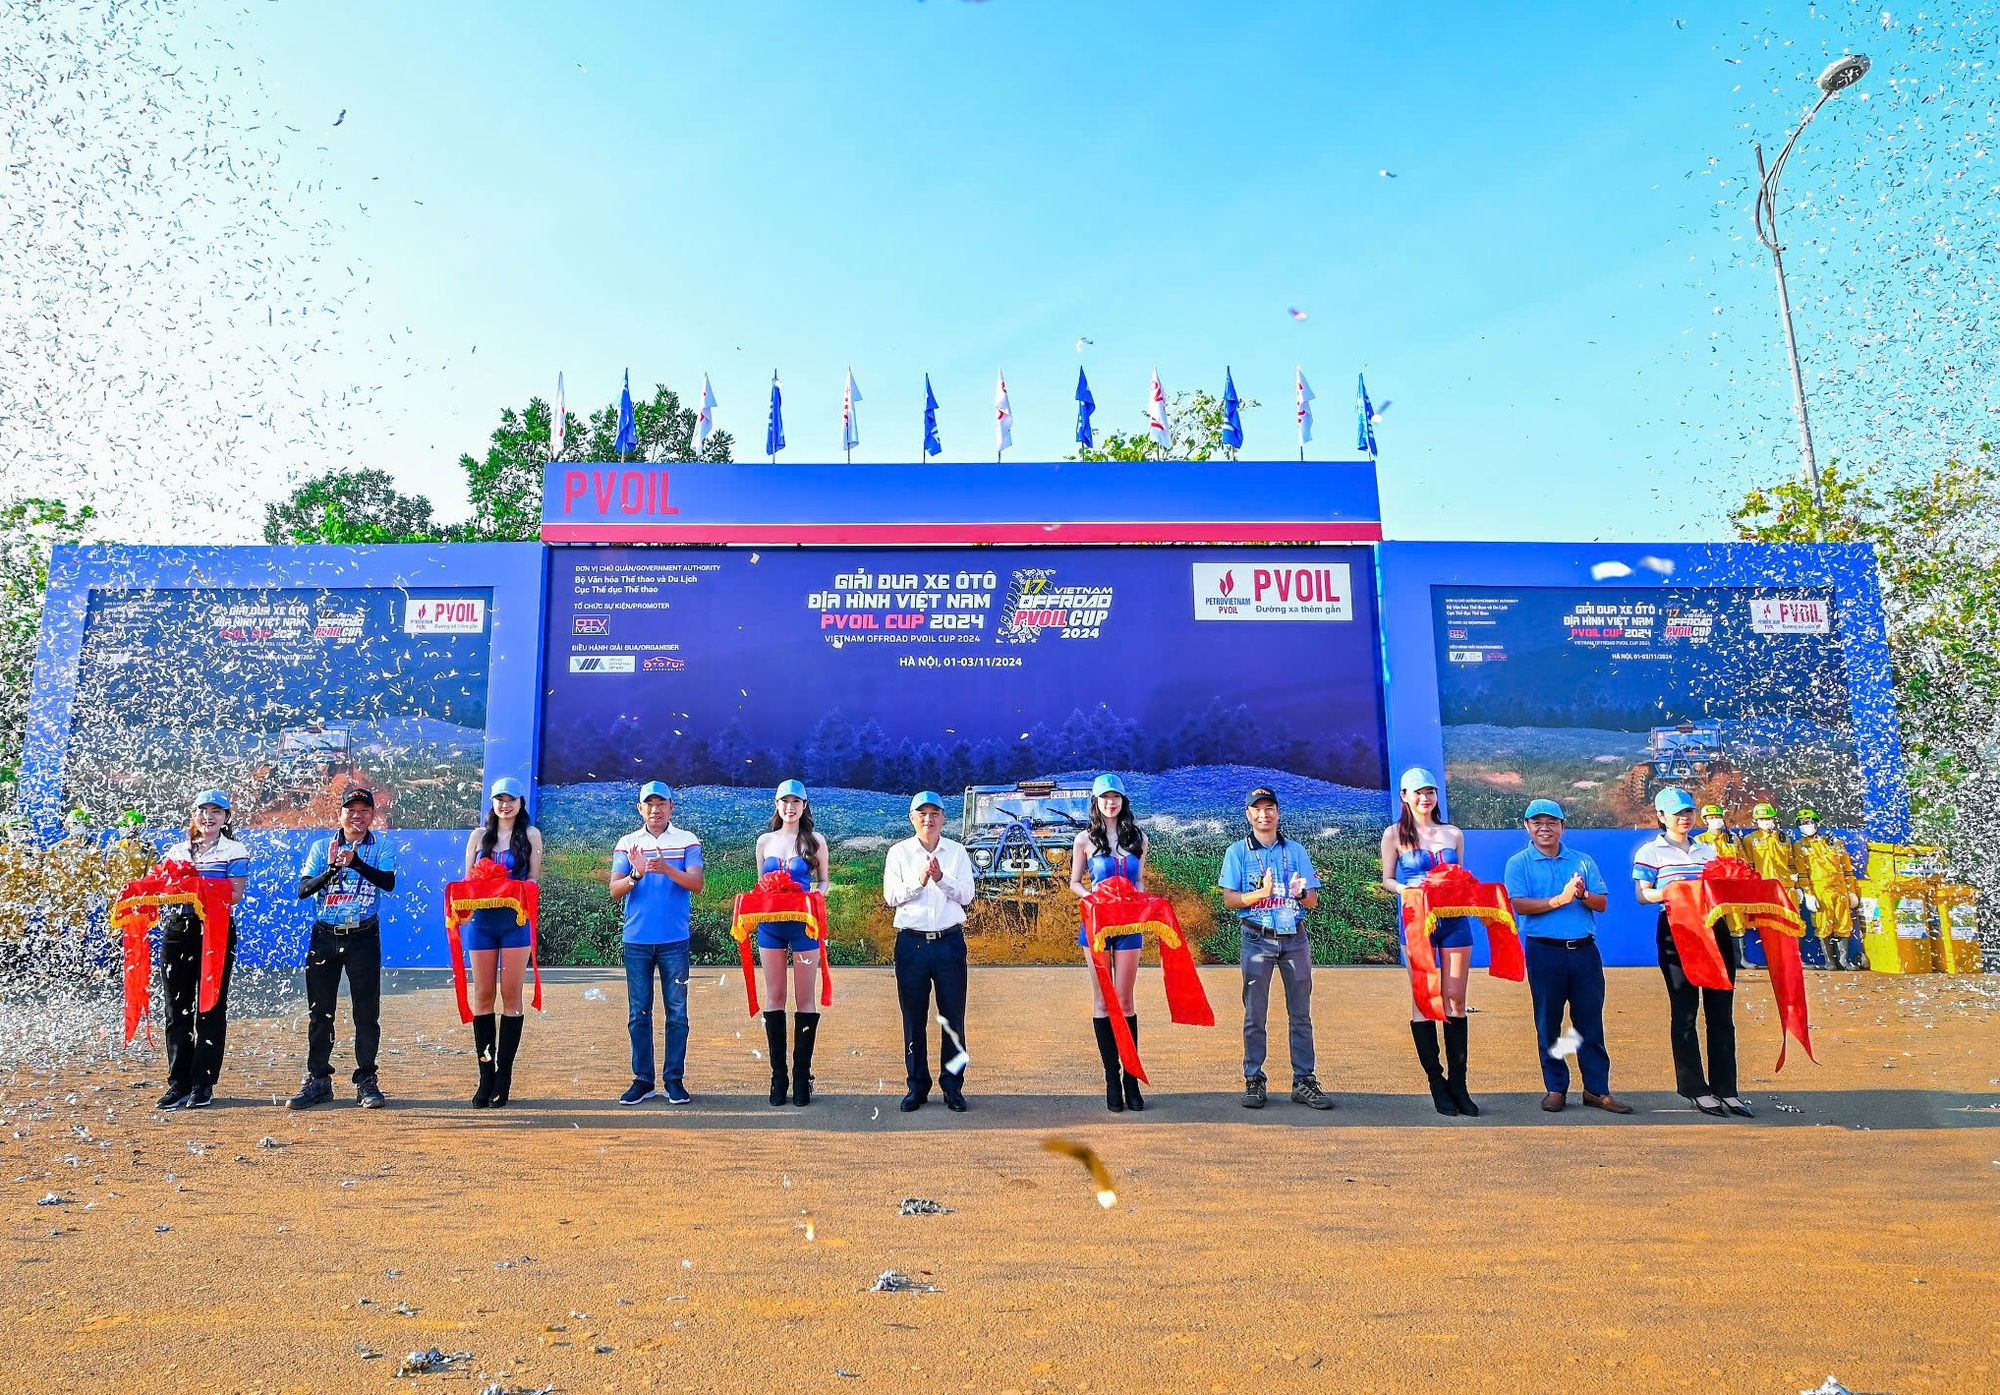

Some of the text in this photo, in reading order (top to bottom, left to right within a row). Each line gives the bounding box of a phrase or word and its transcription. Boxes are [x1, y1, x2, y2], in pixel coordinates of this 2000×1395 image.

[564, 470, 680, 514] PVOIL
[592, 565, 598, 573] VỊ
[575, 576, 586, 585] Bộ
[588, 576, 602, 584] Văn
[604, 575, 619, 583] hóa
[656, 574, 666, 583] và
[680, 575, 698, 585] Lịch
[835, 568, 996, 590] GIẢI ĐUA XE ÔTÔ
[574, 586, 590, 595] Cục
[608, 585, 623, 595] dục
[640, 585, 659, 593] thao
[1023, 579, 1047, 594] 17
[1054, 586, 1112, 594] VIETNAM
[1254, 569, 1340, 602] PVOIL
[808, 590, 990, 612] ĐỊA HÌNH VIỆT NAM
[1019, 594, 1112, 608] OFFROAD
[1206, 598, 1250, 606] PETROVIETNAM
[273, 605, 286, 615] XE
[435, 603, 478, 622] PVOIL
[1218, 606, 1238, 614] PVOIL
[1256, 604, 1286, 614] Đường
[1301, 605, 1322, 613] thêm
[1325, 604, 1341, 614] gần
[1576, 602, 1594, 614] GIẢI
[1597, 605, 1617, 614] ĐUA
[1620, 605, 1632, 614] XE
[1669, 608, 1680, 617] 17
[1780, 604, 1822, 622] PVOIL
[283, 618, 306, 626] NAM
[820, 614, 984, 629] PVOIL CUP 2024
[1014, 610, 1108, 627] PVOIL CUP
[1582, 615, 1604, 625] HÌNH
[1632, 616, 1654, 625] NAM
[1667, 618, 1712, 626] OFFROAD
[342, 627, 362, 637] CUP
[1060, 628, 1100, 639] 2024
[1571, 628, 1651, 638] PVOIL CUP 2024
[1666, 626, 1712, 637] PVOIL CUP
[825, 634, 980, 643] VIETNAM OFFROAD PVOIL CUP 2024
[900, 656, 1022, 669] HÀ NỘI, 01-03/11/2024
